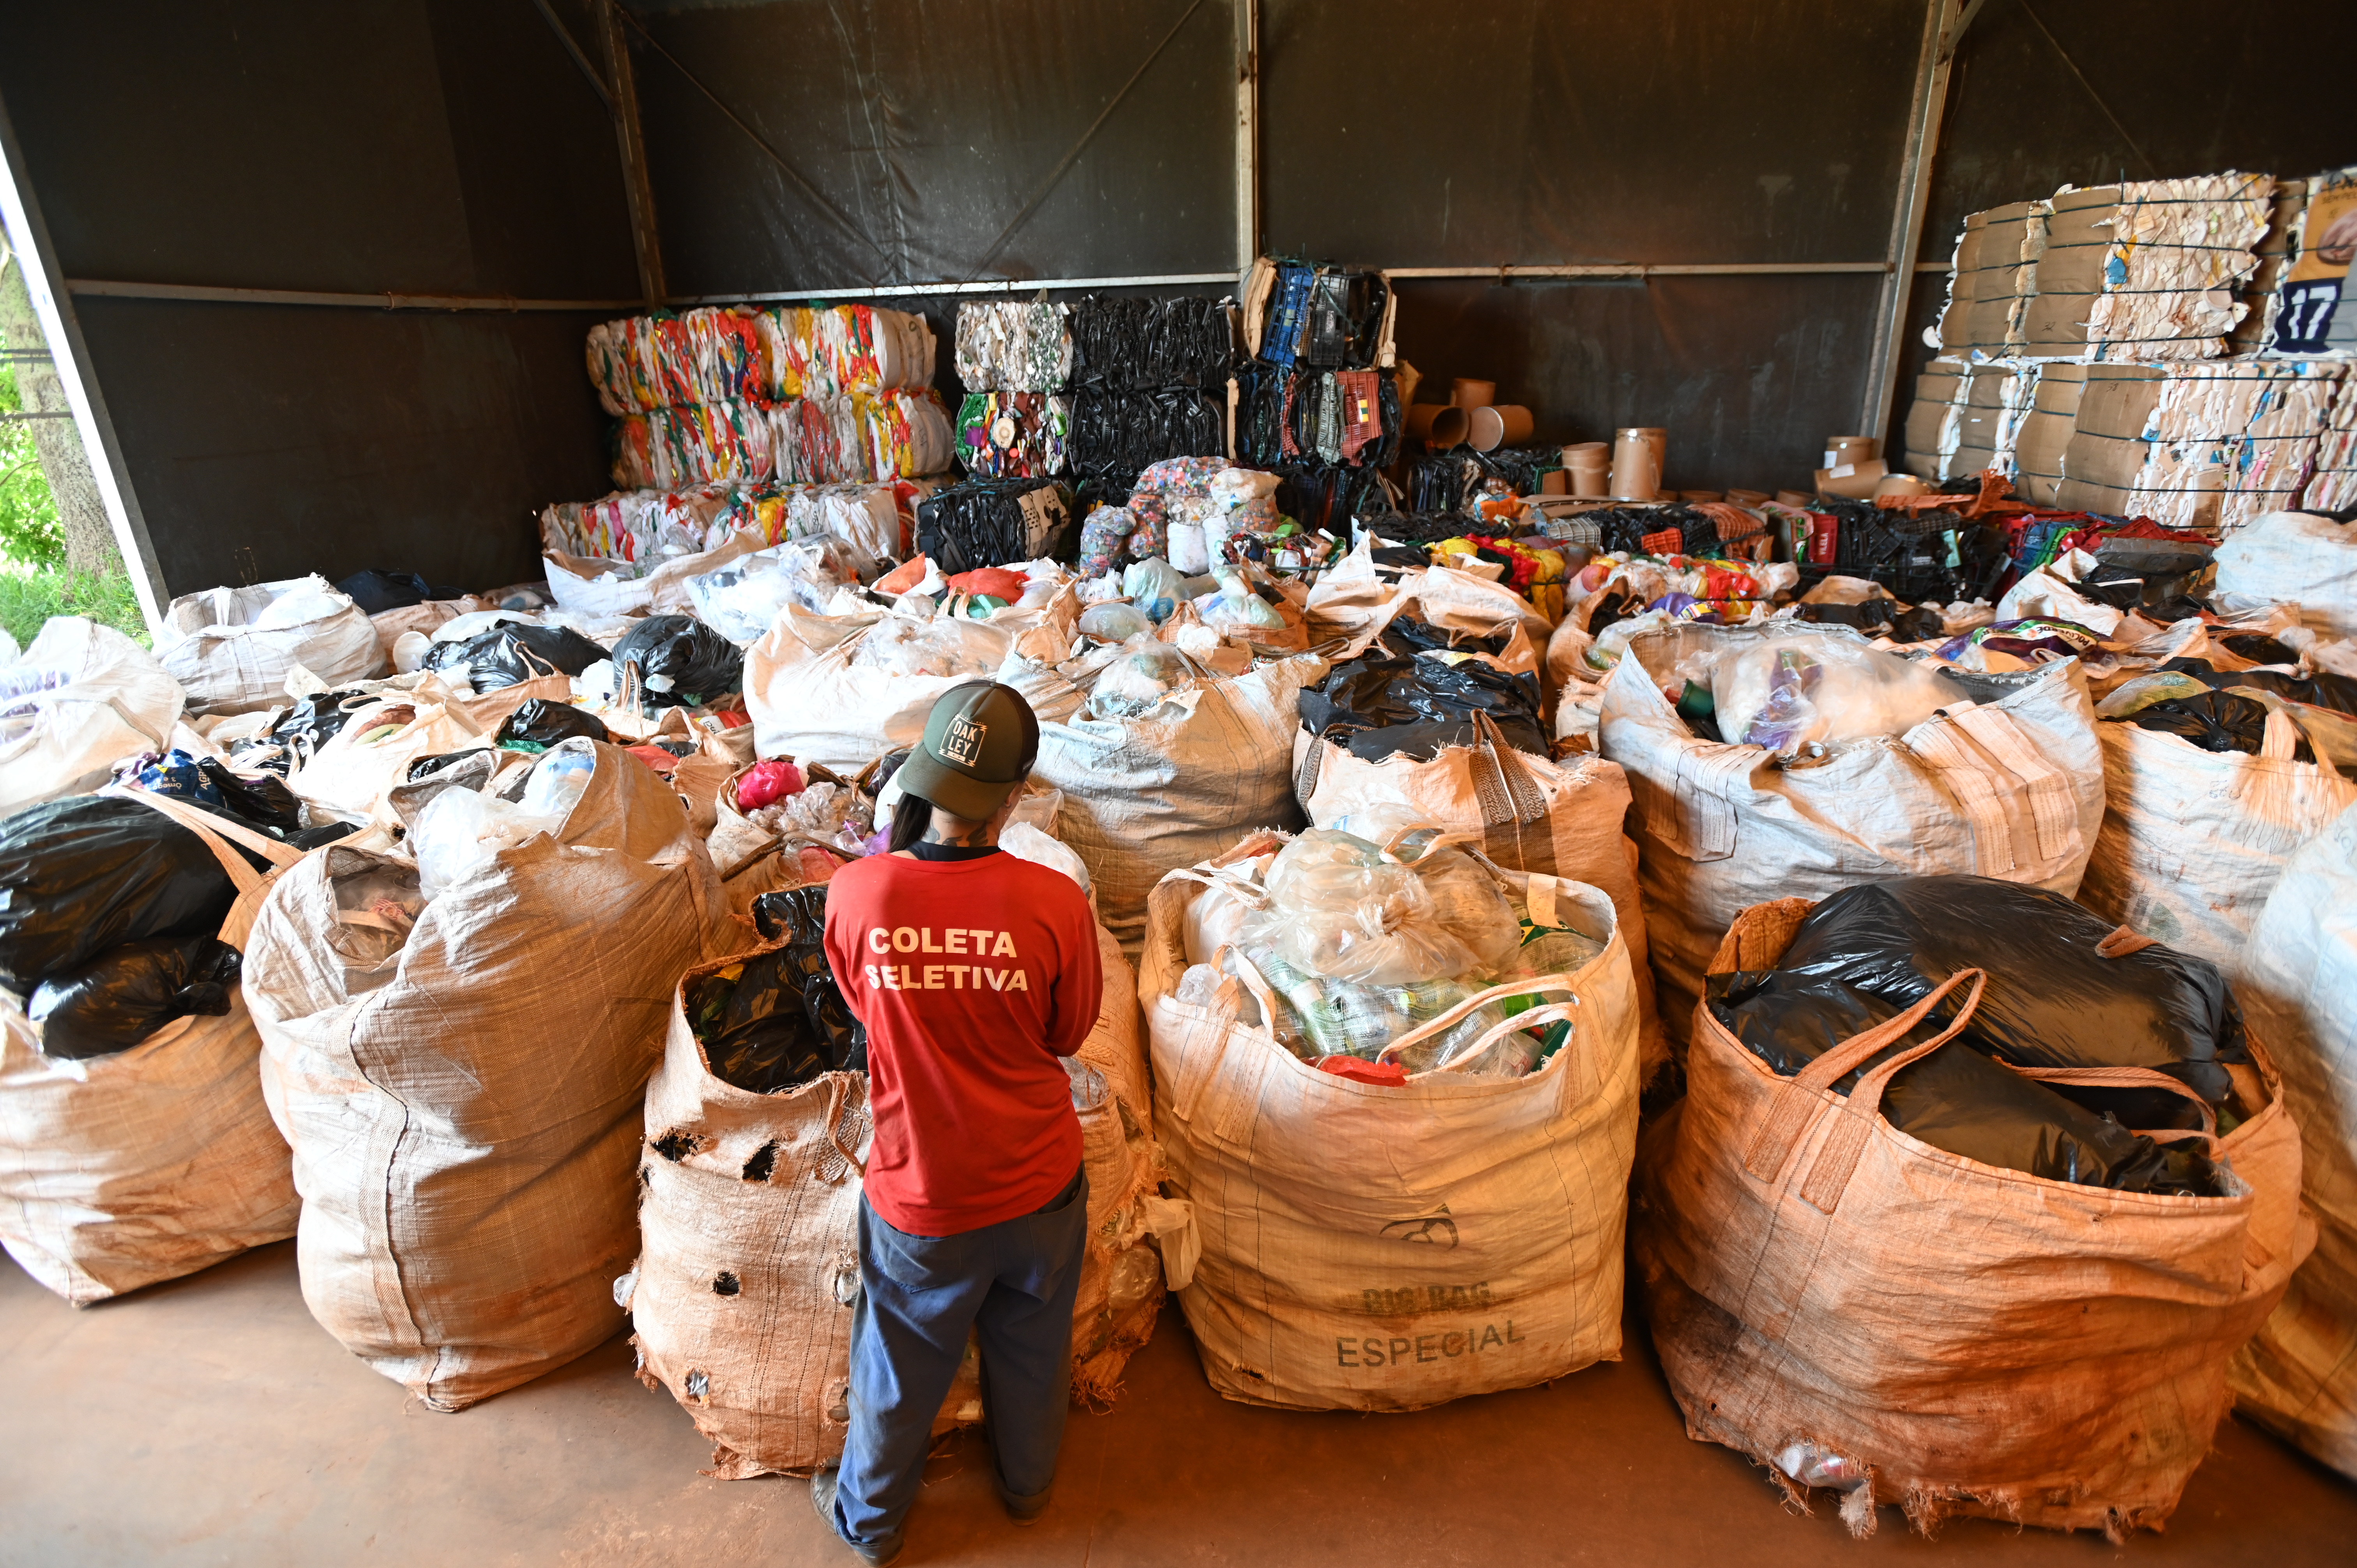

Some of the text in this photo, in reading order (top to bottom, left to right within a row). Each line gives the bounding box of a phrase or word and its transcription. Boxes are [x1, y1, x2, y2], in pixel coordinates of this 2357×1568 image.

[2290, 285, 2337, 340] 17
[1819, 533, 1829, 555] VILELA
[2036, 626, 2090, 646] POLIVERDE
[953, 720, 978, 742] OAK
[948, 736, 972, 756] LEY
[868, 927, 1018, 958] COLETA
[864, 964, 1028, 992] SELETIVA
[1363, 1281, 1491, 1314] BIG BAG
[1336, 1319, 1526, 1368] ESPECIAL
